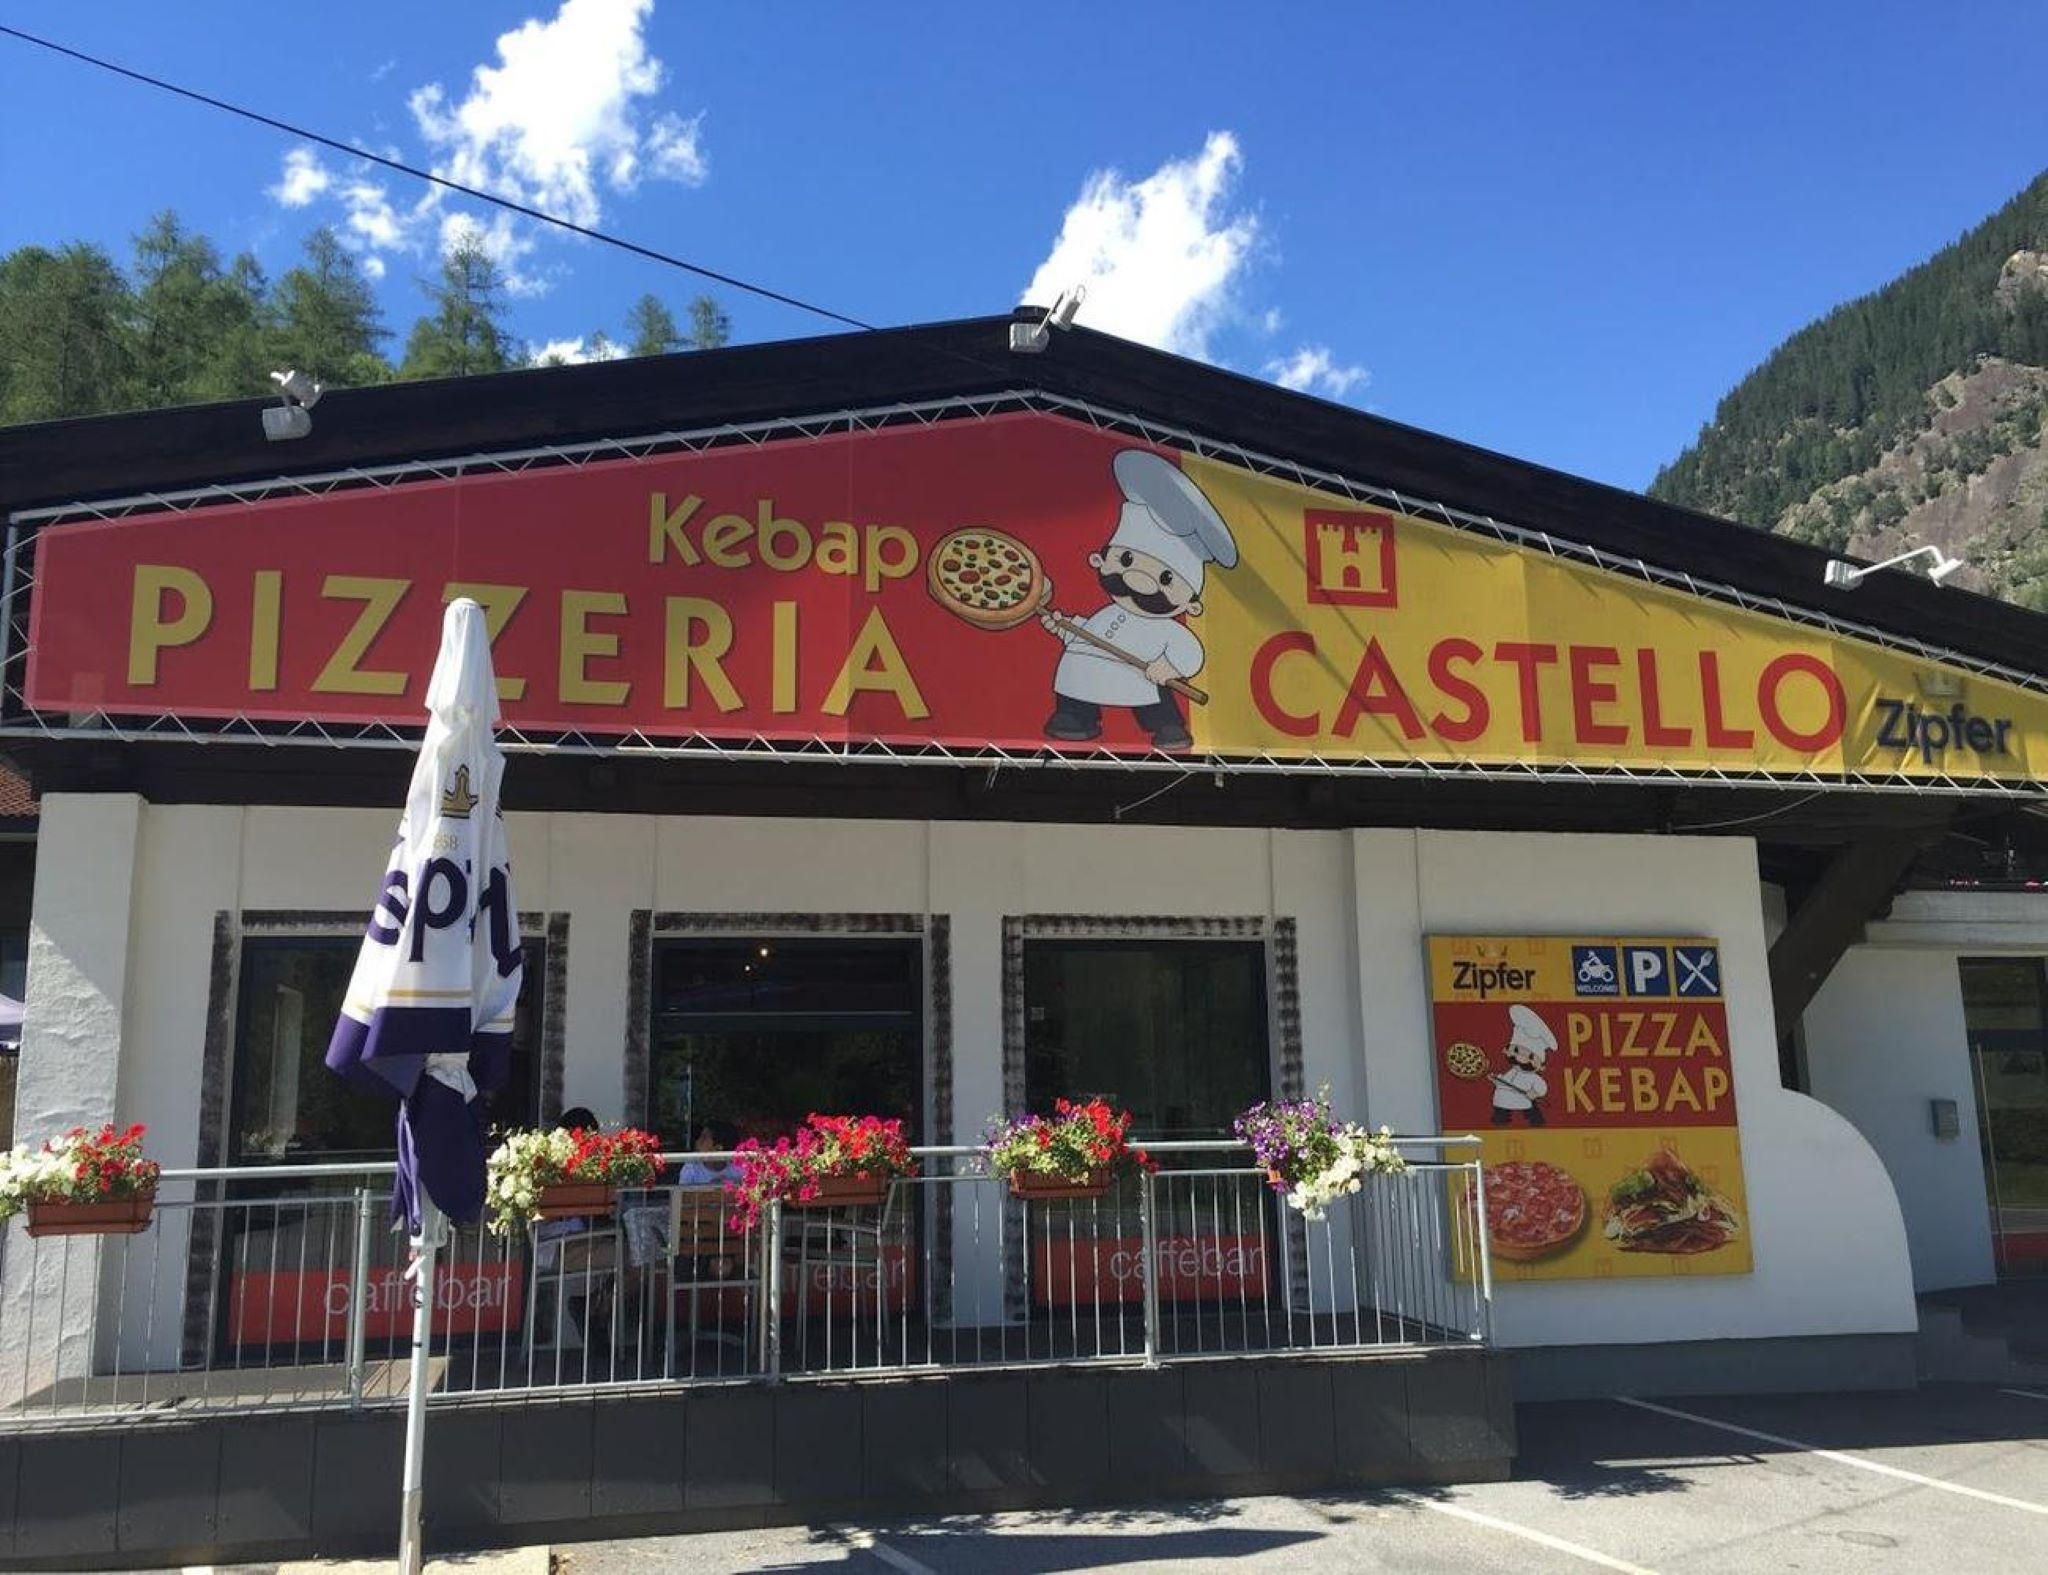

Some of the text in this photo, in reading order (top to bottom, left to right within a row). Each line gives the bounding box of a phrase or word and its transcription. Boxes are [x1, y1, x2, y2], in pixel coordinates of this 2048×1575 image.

[649, 492, 919, 592] Kebap
[127, 565, 931, 719] PIZZERIA
[1250, 630, 1846, 753] CASTELLO
[1876, 698, 2012, 764] Zipfer
[1452, 960, 1536, 999] Zipfer
[1631, 951, 1662, 993] P
[1566, 1011, 1723, 1058] PIZZA
[1562, 1066, 1729, 1115] KEBAP
